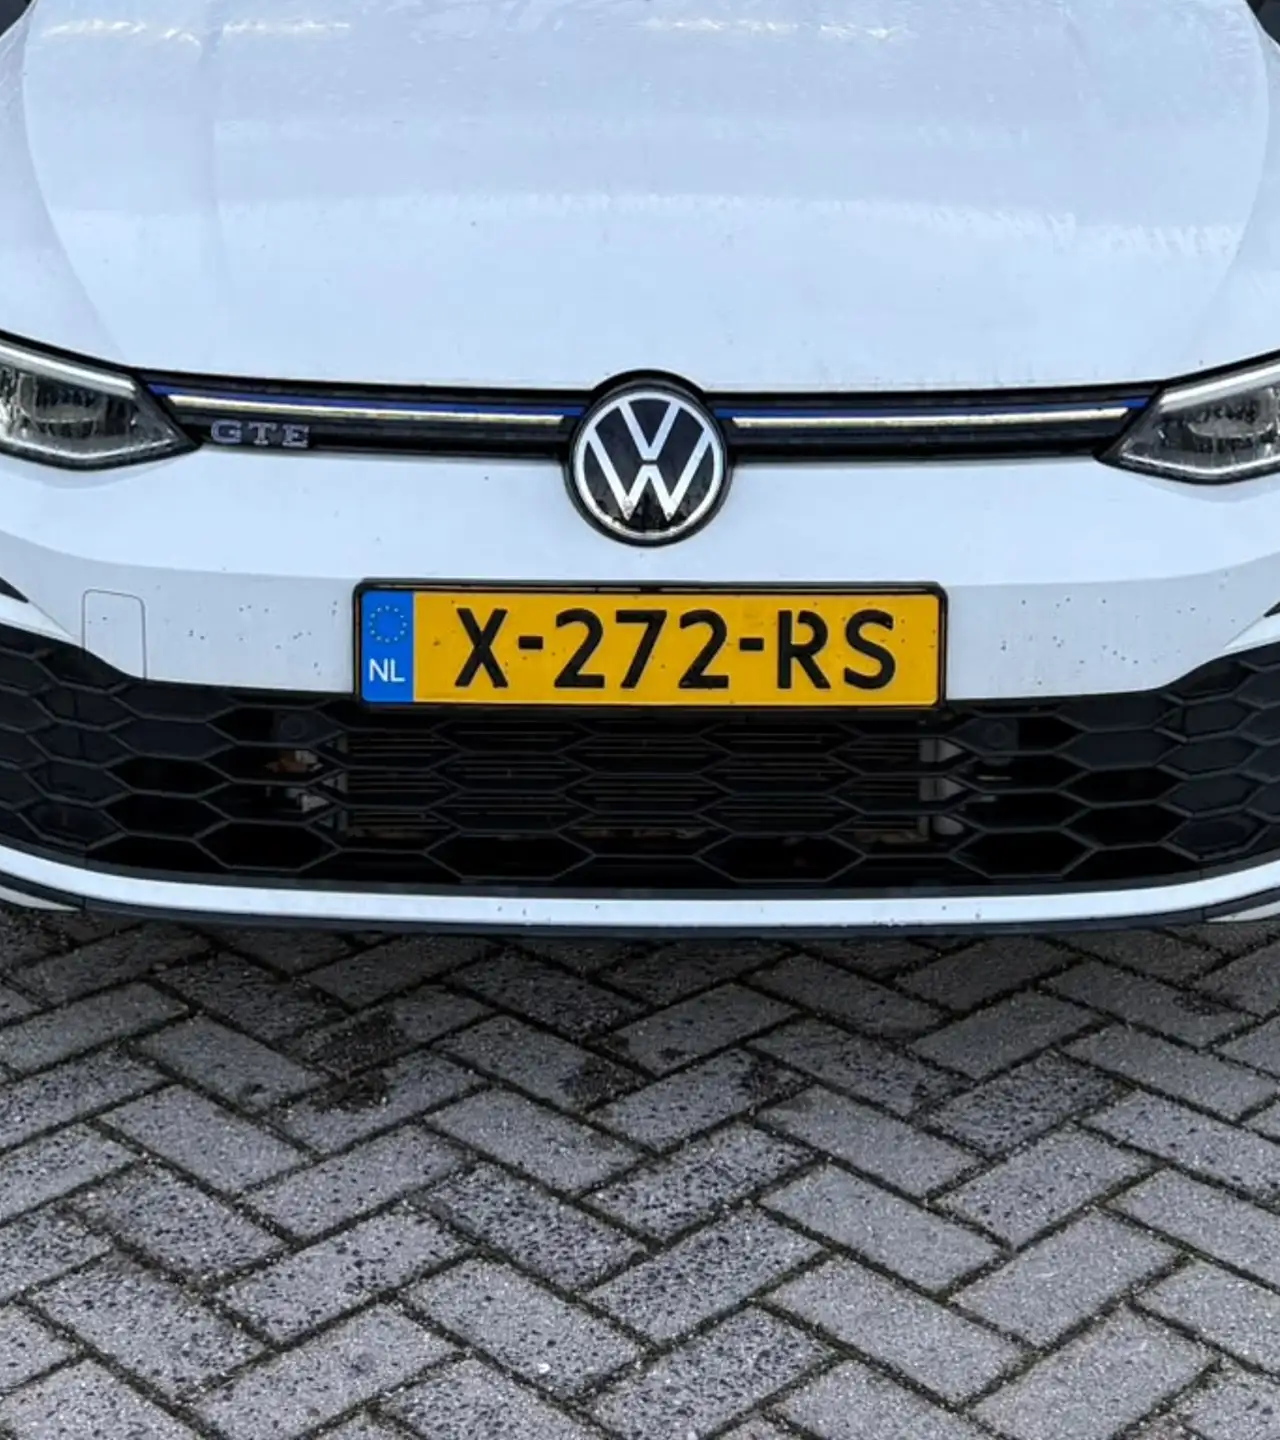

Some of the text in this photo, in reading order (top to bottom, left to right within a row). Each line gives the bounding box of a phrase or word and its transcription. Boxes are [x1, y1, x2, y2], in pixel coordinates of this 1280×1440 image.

[209, 419, 310, 448] GTE
[454, 606, 896, 691] X-272-RS
[368, 658, 405, 684] NL
